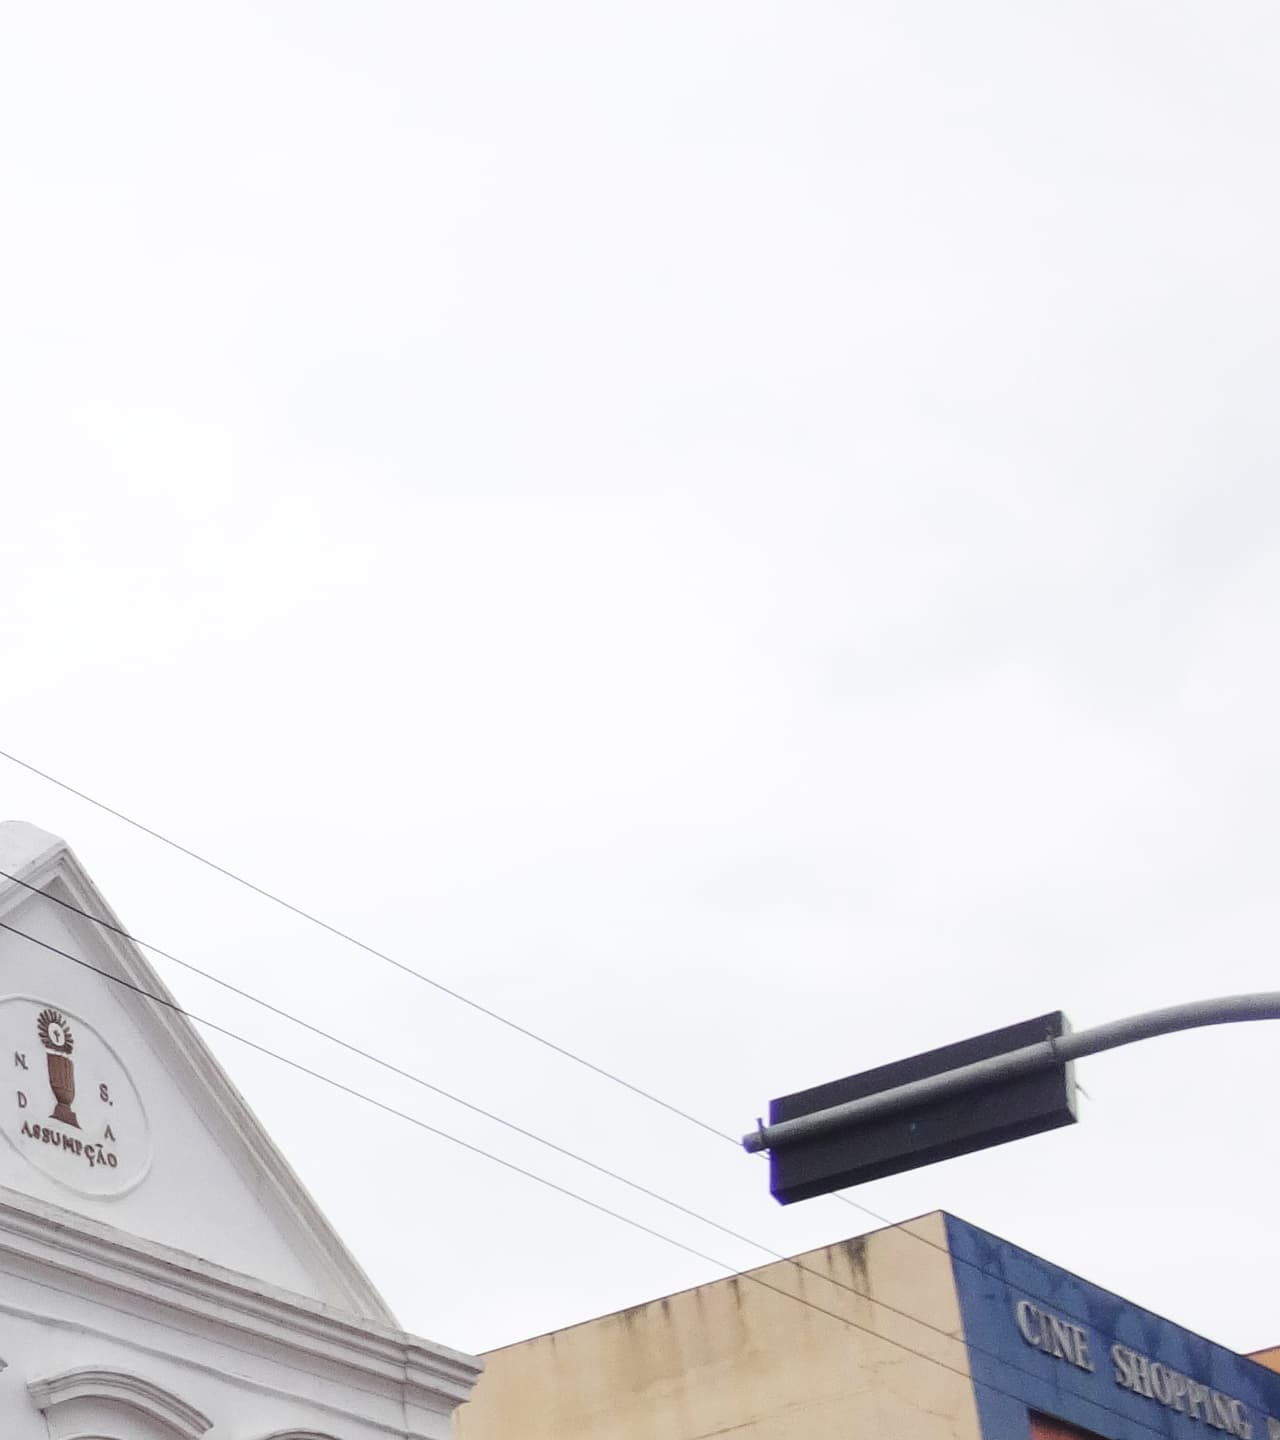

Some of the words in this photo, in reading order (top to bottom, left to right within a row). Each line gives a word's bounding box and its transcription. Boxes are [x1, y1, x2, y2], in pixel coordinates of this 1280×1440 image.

[17, 1090, 28, 1109] D
[20, 1119, 118, 1168] ASSUMPÇÃO
[1016, 1300, 1095, 1373] CINE
[1111, 1343, 1252, 1440] SHOPPING
